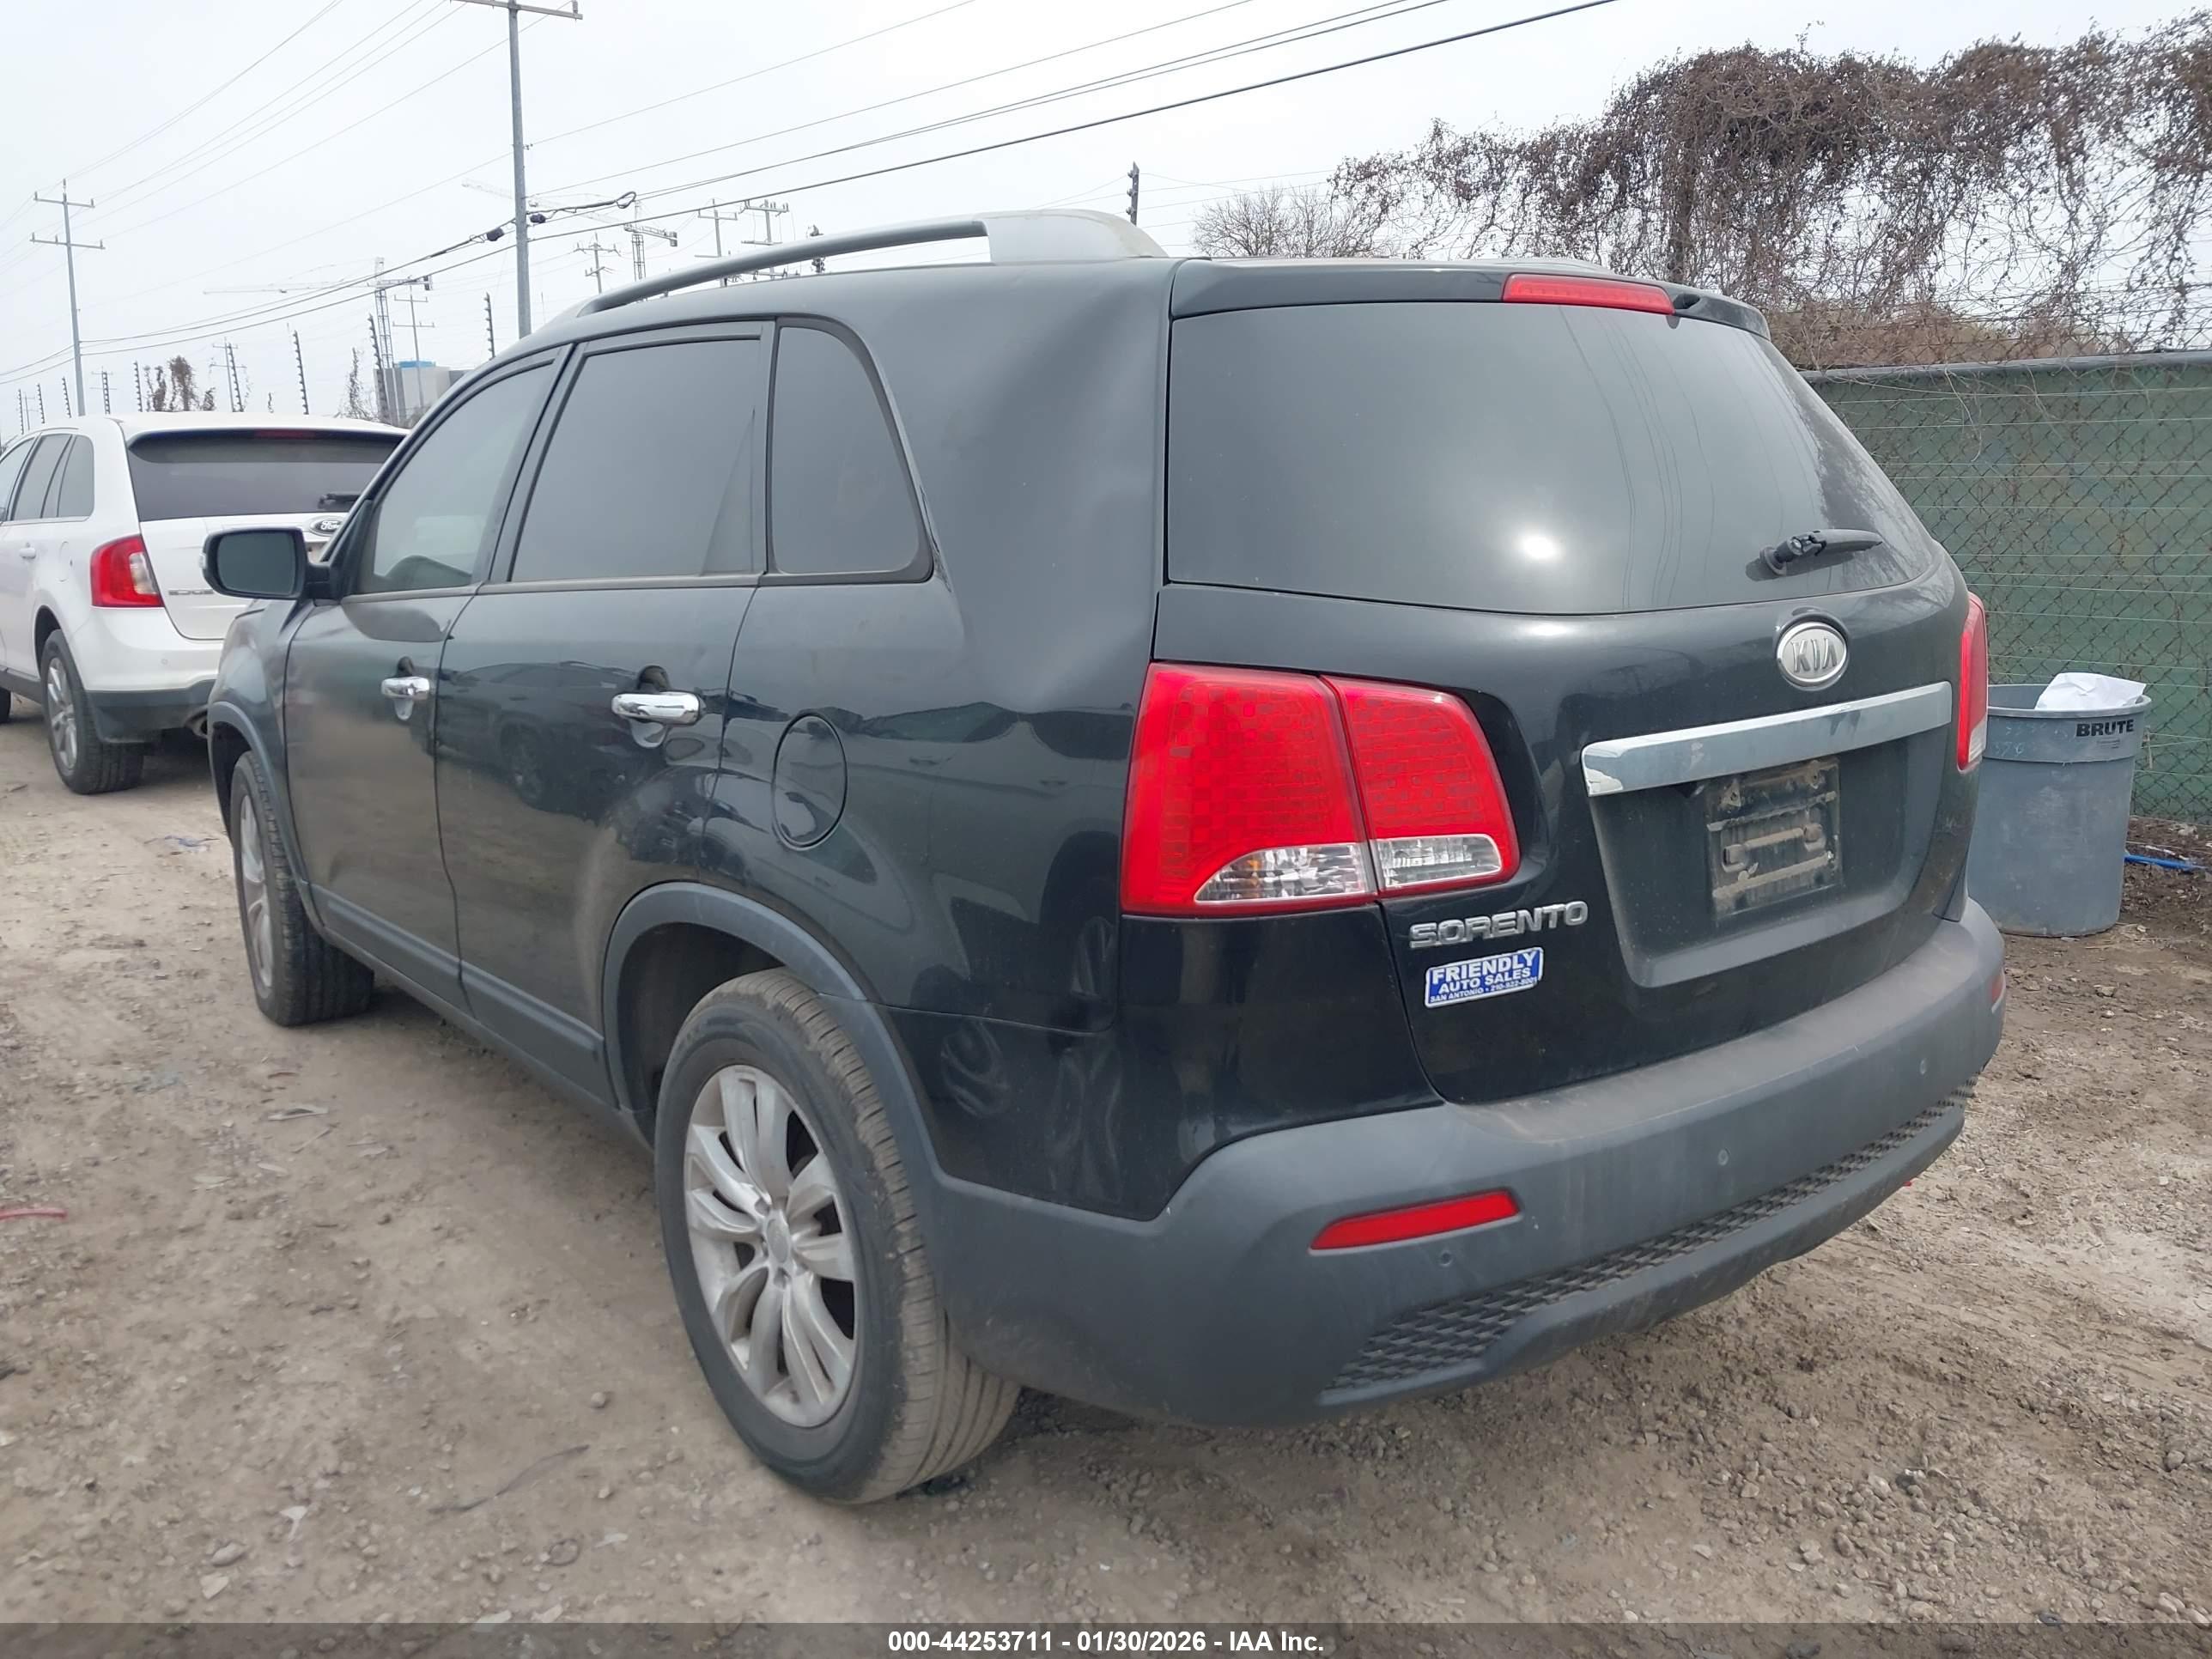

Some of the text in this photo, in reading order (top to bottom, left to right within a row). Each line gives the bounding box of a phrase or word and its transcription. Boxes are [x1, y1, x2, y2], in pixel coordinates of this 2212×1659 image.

[1790, 637, 1838, 673] KIA
[2075, 719, 2135, 738] BRUTE
[1409, 901, 1589, 949] SORENTO
[1431, 951, 1537, 985] FRIENDLY
[1438, 968, 1531, 995] AUTO SALES
[1430, 994, 1447, 1003] SAN
[1448, 987, 1484, 1000] ANTONIO
